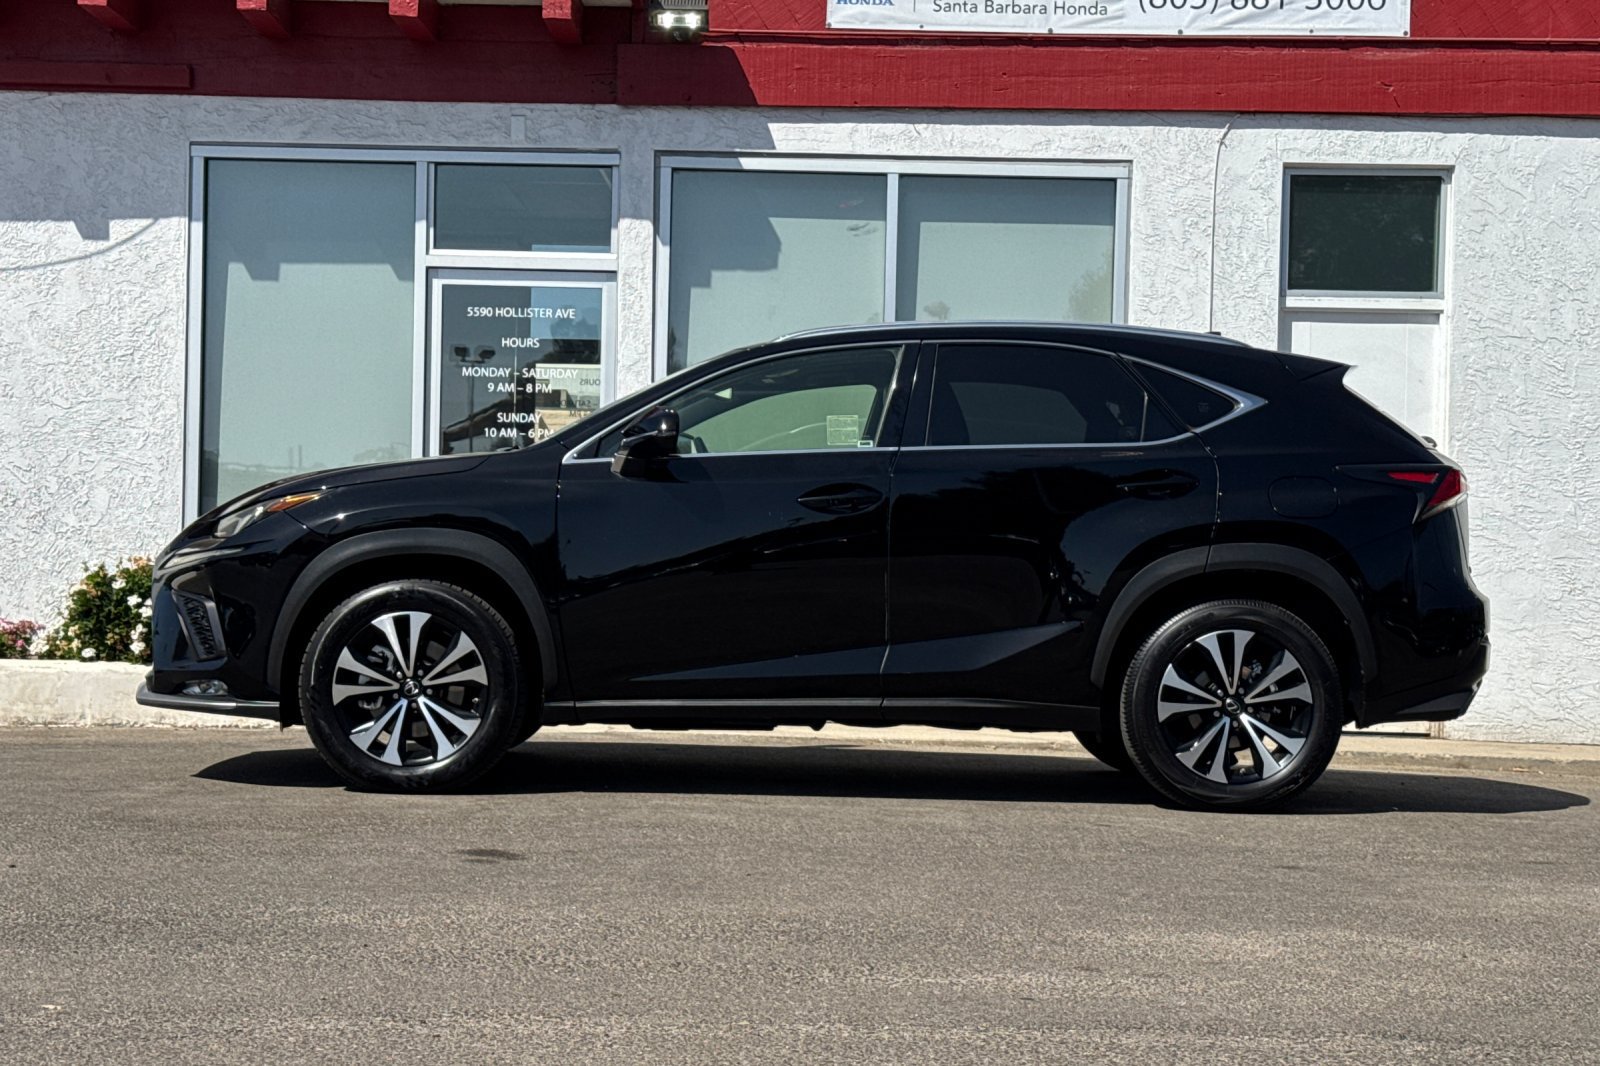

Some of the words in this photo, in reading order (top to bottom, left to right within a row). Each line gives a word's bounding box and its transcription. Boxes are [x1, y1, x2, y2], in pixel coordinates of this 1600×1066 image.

[933, 0, 978, 13] Santa
[984, 0, 1047, 15] Barbara
[1054, 0, 1107, 15] Honda
[466, 307, 493, 317] 5590
[495, 307, 553, 318] HOLLISTER
[555, 308, 576, 319] AVE
[501, 337, 540, 348] HOURS
[461, 366, 511, 378] MONDAY
[522, 367, 578, 379] SATURDAY
[487, 382, 495, 392] 9
[496, 383, 515, 393] AM
[525, 383, 533, 393] 8
[535, 383, 552, 394] PM
[497, 412, 542, 423] SUNDAY
[484, 427, 497, 437] 10
[499, 428, 517, 438] AM
[528, 428, 535, 438] 6
